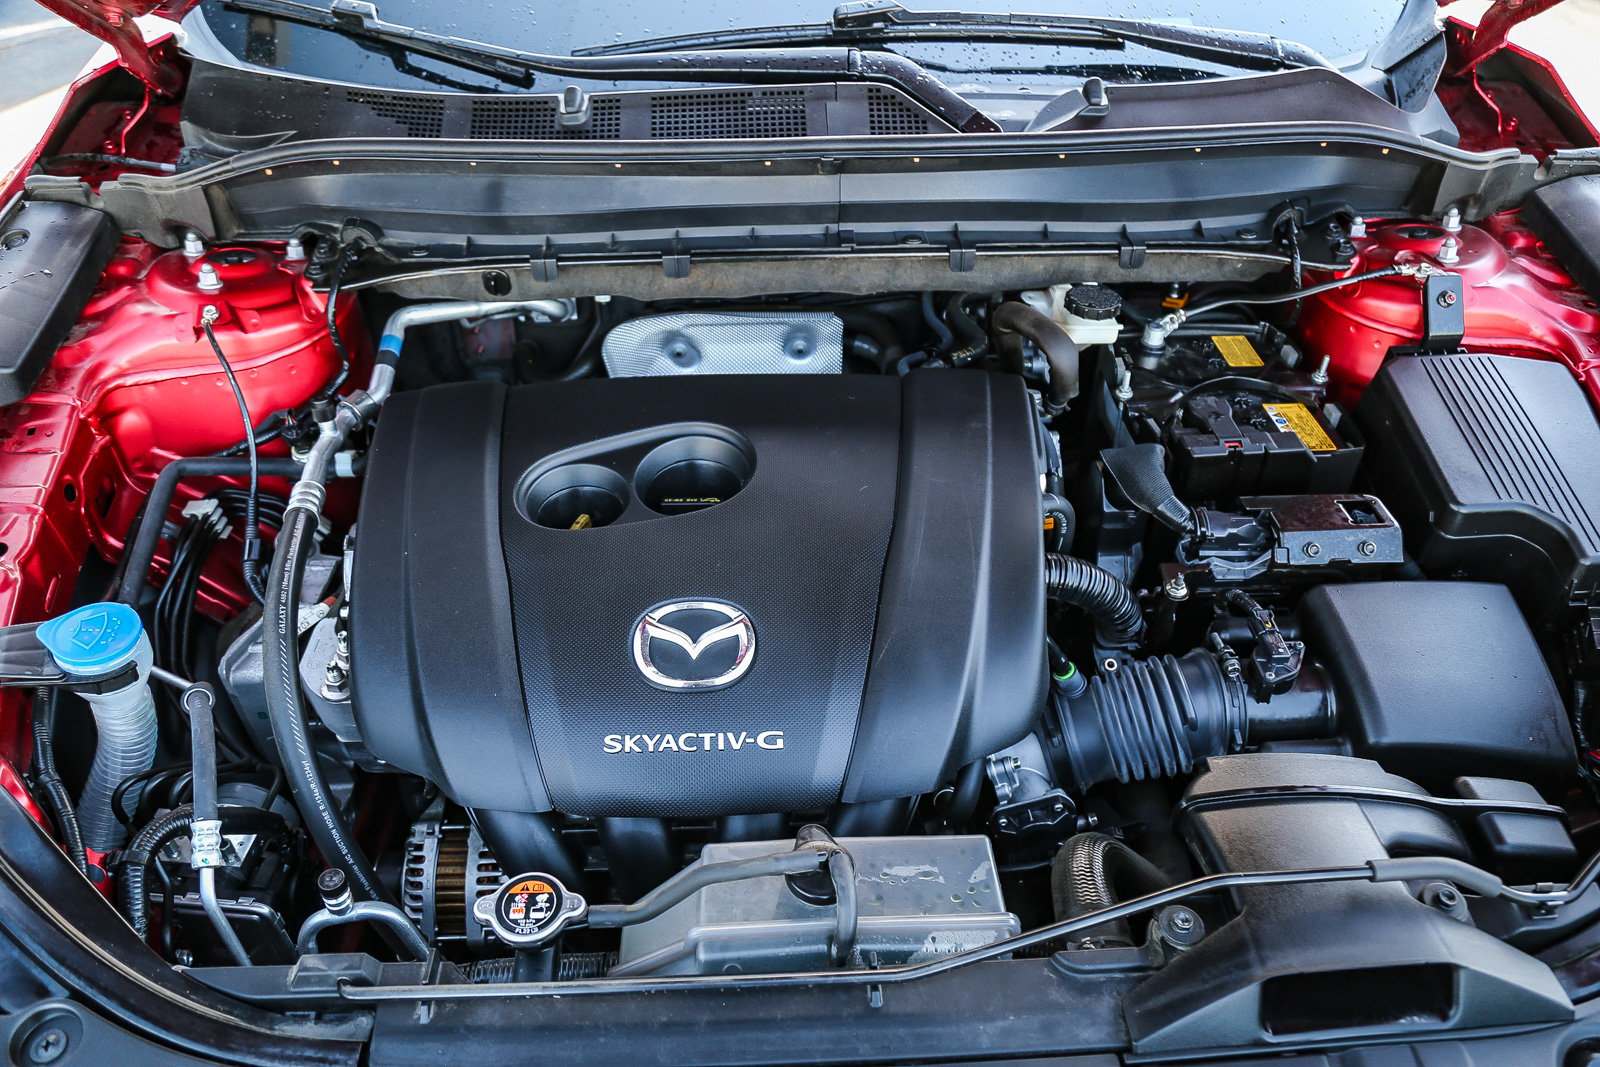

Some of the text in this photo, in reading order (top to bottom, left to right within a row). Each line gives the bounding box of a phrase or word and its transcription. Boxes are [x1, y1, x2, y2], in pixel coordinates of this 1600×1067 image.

[279, 604, 287, 634] GALAXY
[603, 730, 785, 754] SKYACTIV-G
[321, 810, 335, 829] HOSE
[330, 828, 348, 855] SUCTION
